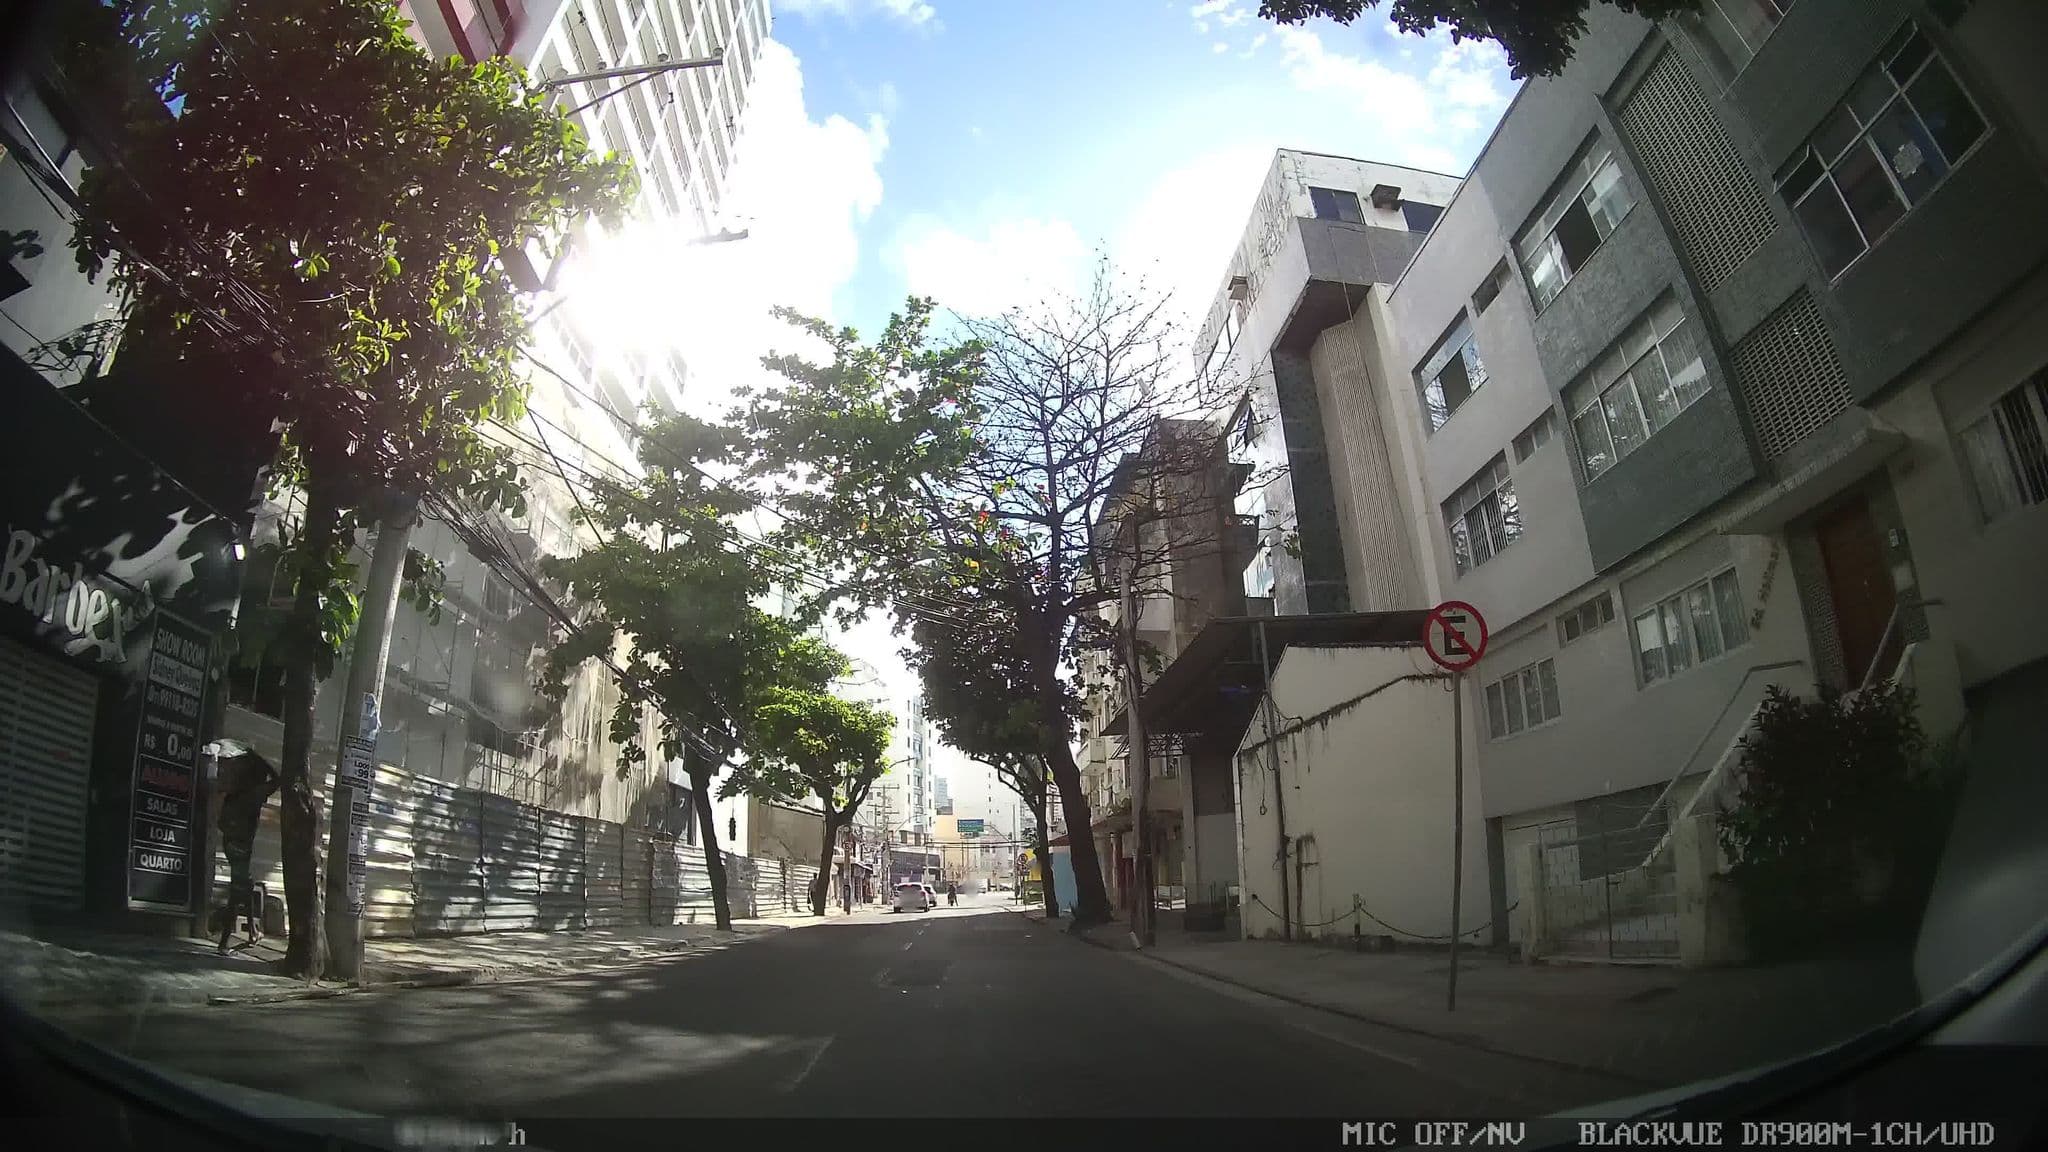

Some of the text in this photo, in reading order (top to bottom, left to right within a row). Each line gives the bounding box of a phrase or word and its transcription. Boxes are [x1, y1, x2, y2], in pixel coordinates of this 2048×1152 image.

[1443, 615, 1470, 656] E
[154, 628, 206, 668] SHOW ROOM
[147, 797, 178, 816] SALAS
[149, 826, 175, 843] LOJA
[140, 853, 183, 871] QUARTO
